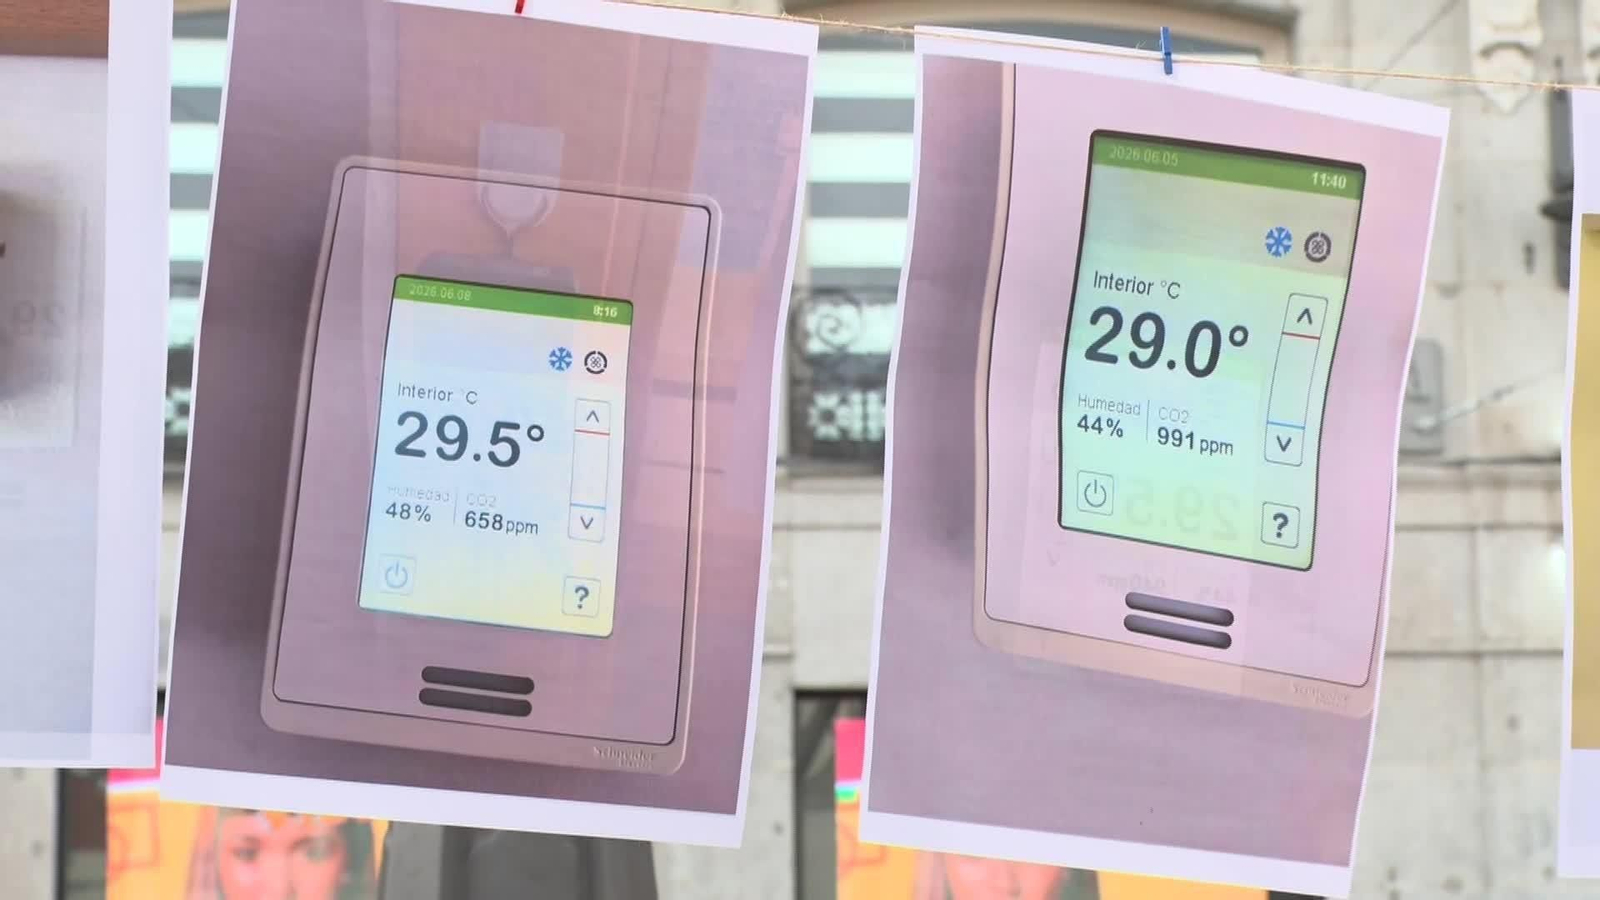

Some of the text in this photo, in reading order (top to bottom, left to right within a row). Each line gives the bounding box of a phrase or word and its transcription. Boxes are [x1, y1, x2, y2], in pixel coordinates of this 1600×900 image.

[1310, 171, 1347, 190] 11:40
[1093, 270, 1181, 300] Interior °C
[593, 304, 618, 318] 8:16
[1084, 306, 1249, 379] 29.0°
[398, 382, 454, 402] Interior
[1077, 393, 1142, 416] Humedad
[1158, 406, 1190, 425] CO2
[1077, 414, 1124, 438] 44%
[394, 410, 545, 468] 29.5°
[1157, 427, 1234, 457] 991 ppm
[466, 492, 498, 508] CO2
[385, 502, 432, 523] 48%
[1273, 512, 1290, 539] ?
[574, 585, 590, 610] ?
